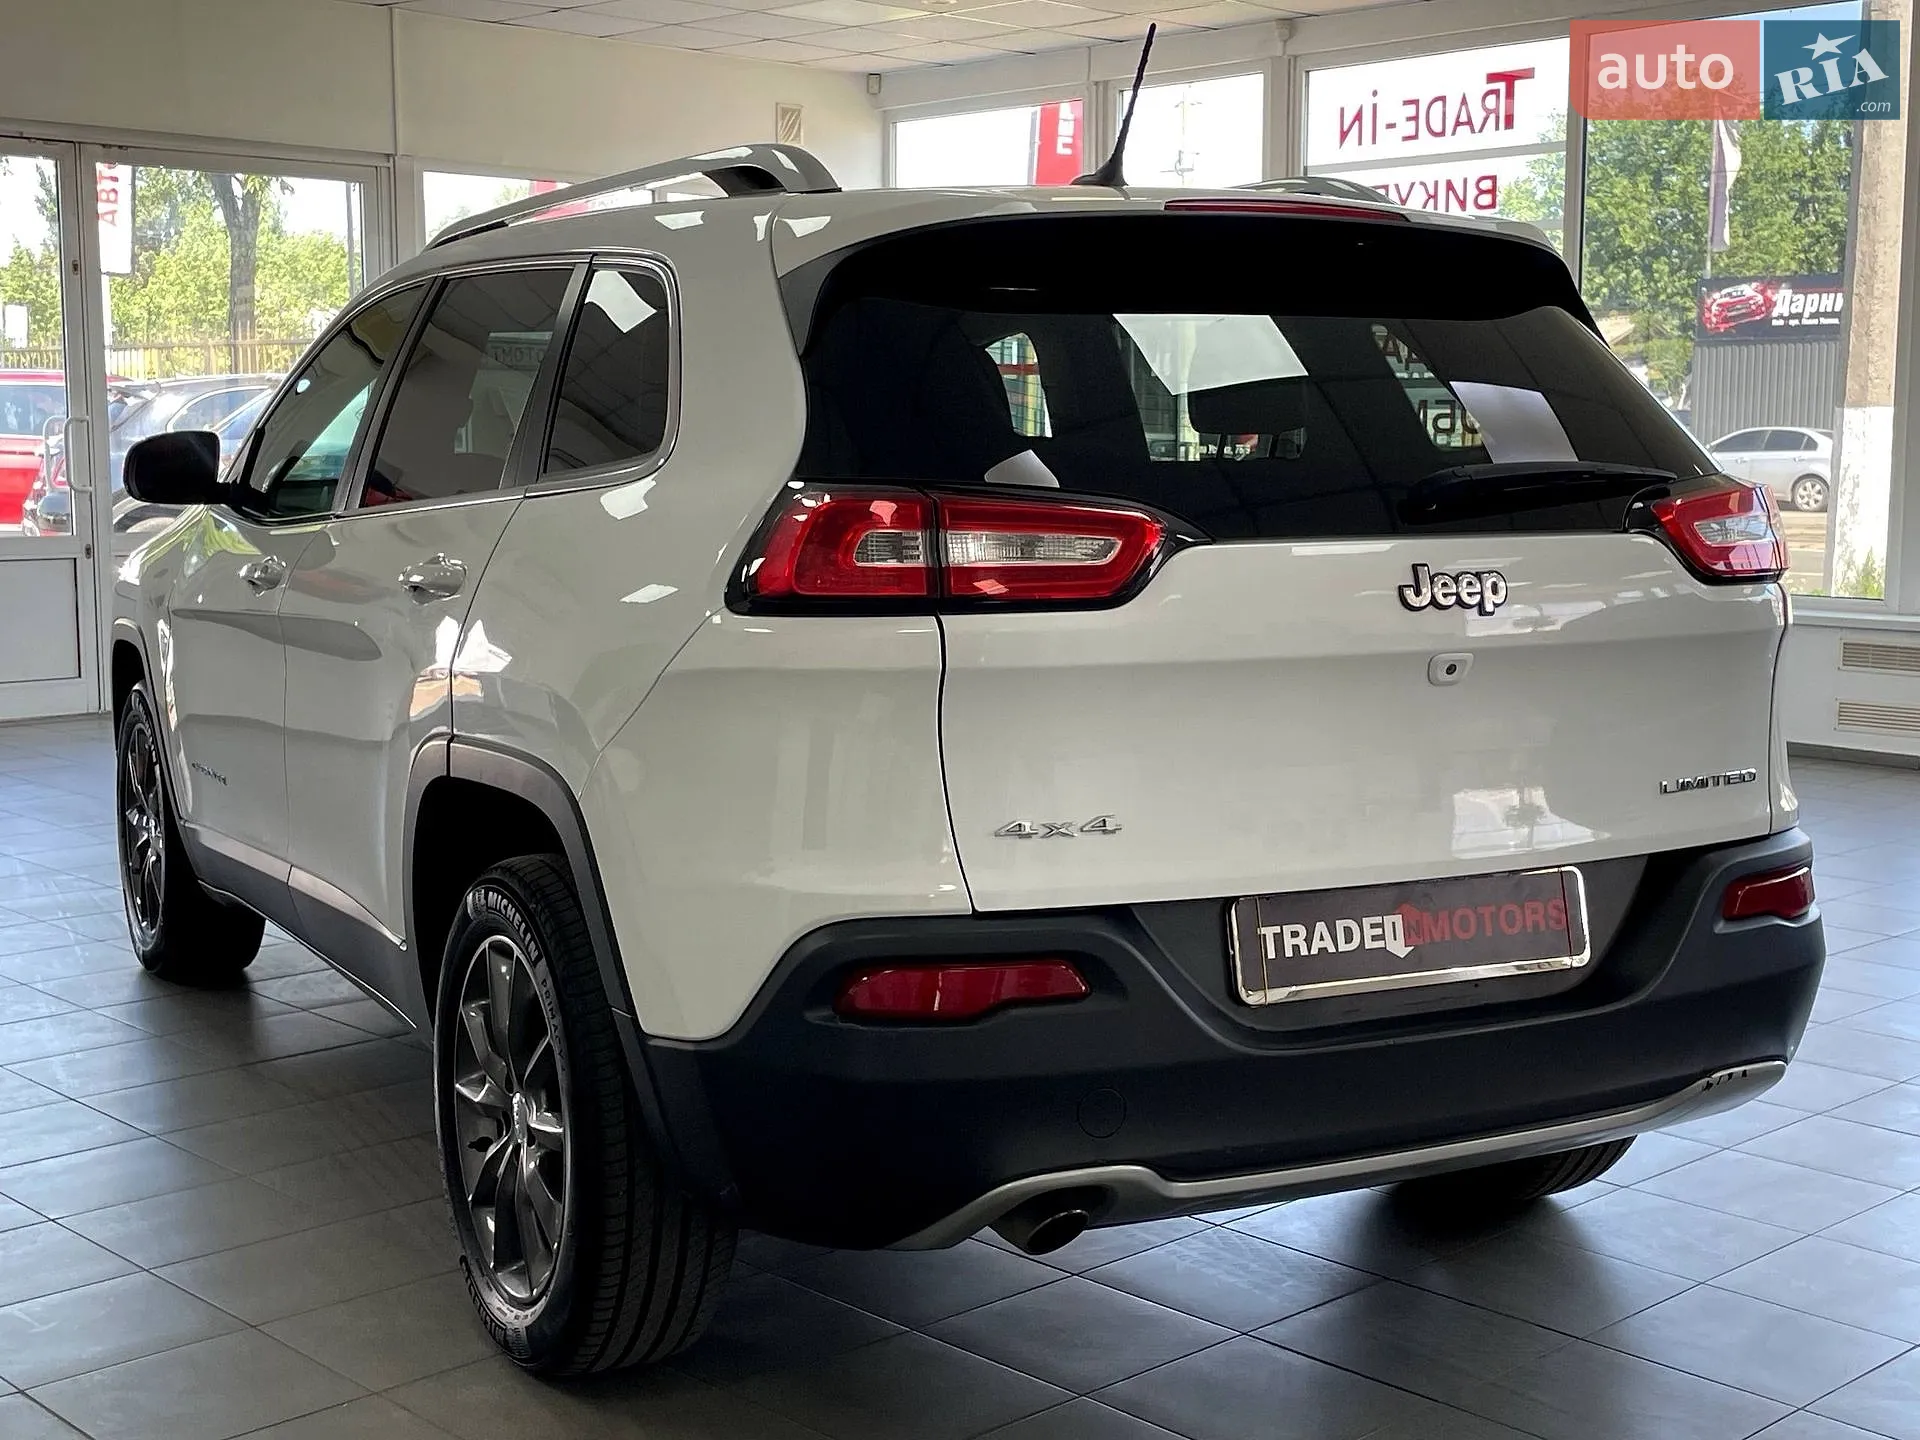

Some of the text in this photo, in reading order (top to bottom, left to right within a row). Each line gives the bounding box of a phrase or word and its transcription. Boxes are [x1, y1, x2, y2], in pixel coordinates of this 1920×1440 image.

[1398, 563, 1508, 616] Jeep
[1659, 767, 1758, 795] LIMITED
[487, 891, 540, 962] MICHELIN
[1422, 899, 1566, 945] MOTORS
